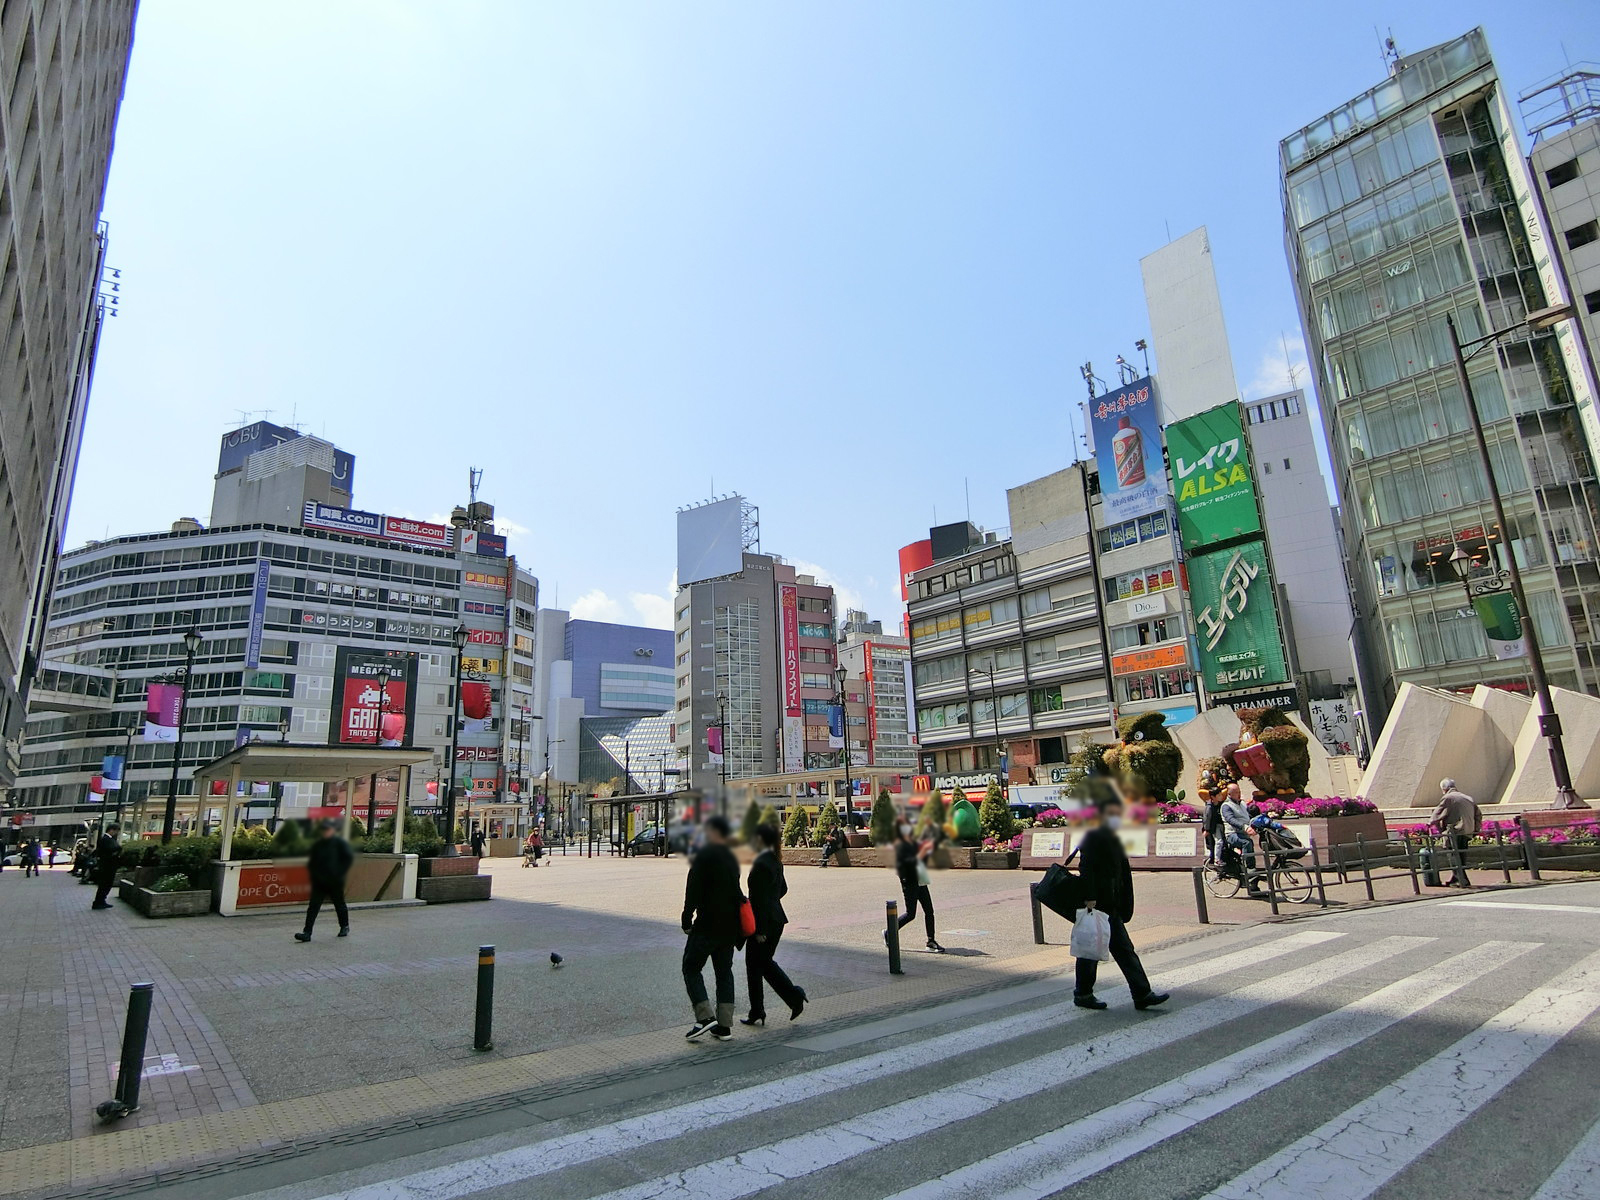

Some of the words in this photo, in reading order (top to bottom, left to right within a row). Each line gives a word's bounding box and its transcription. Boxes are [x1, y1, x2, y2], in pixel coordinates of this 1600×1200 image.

[222, 424, 260, 450] TOBU
[1175, 438, 1239, 479] レイク
[1179, 463, 1247, 501] ALSA
[1197, 550, 1259, 652] エイブル
[434, 627, 451, 637] 7F
[468, 631, 502, 644] イフル
[803, 627, 824, 638] NOVA
[351, 666, 402, 677] MEGAGE
[788, 650, 798, 707] ハウスメイト
[1334, 703, 1348, 723] 焼肉
[456, 750, 486, 758] アコム
[935, 773, 998, 790] McDonald's
